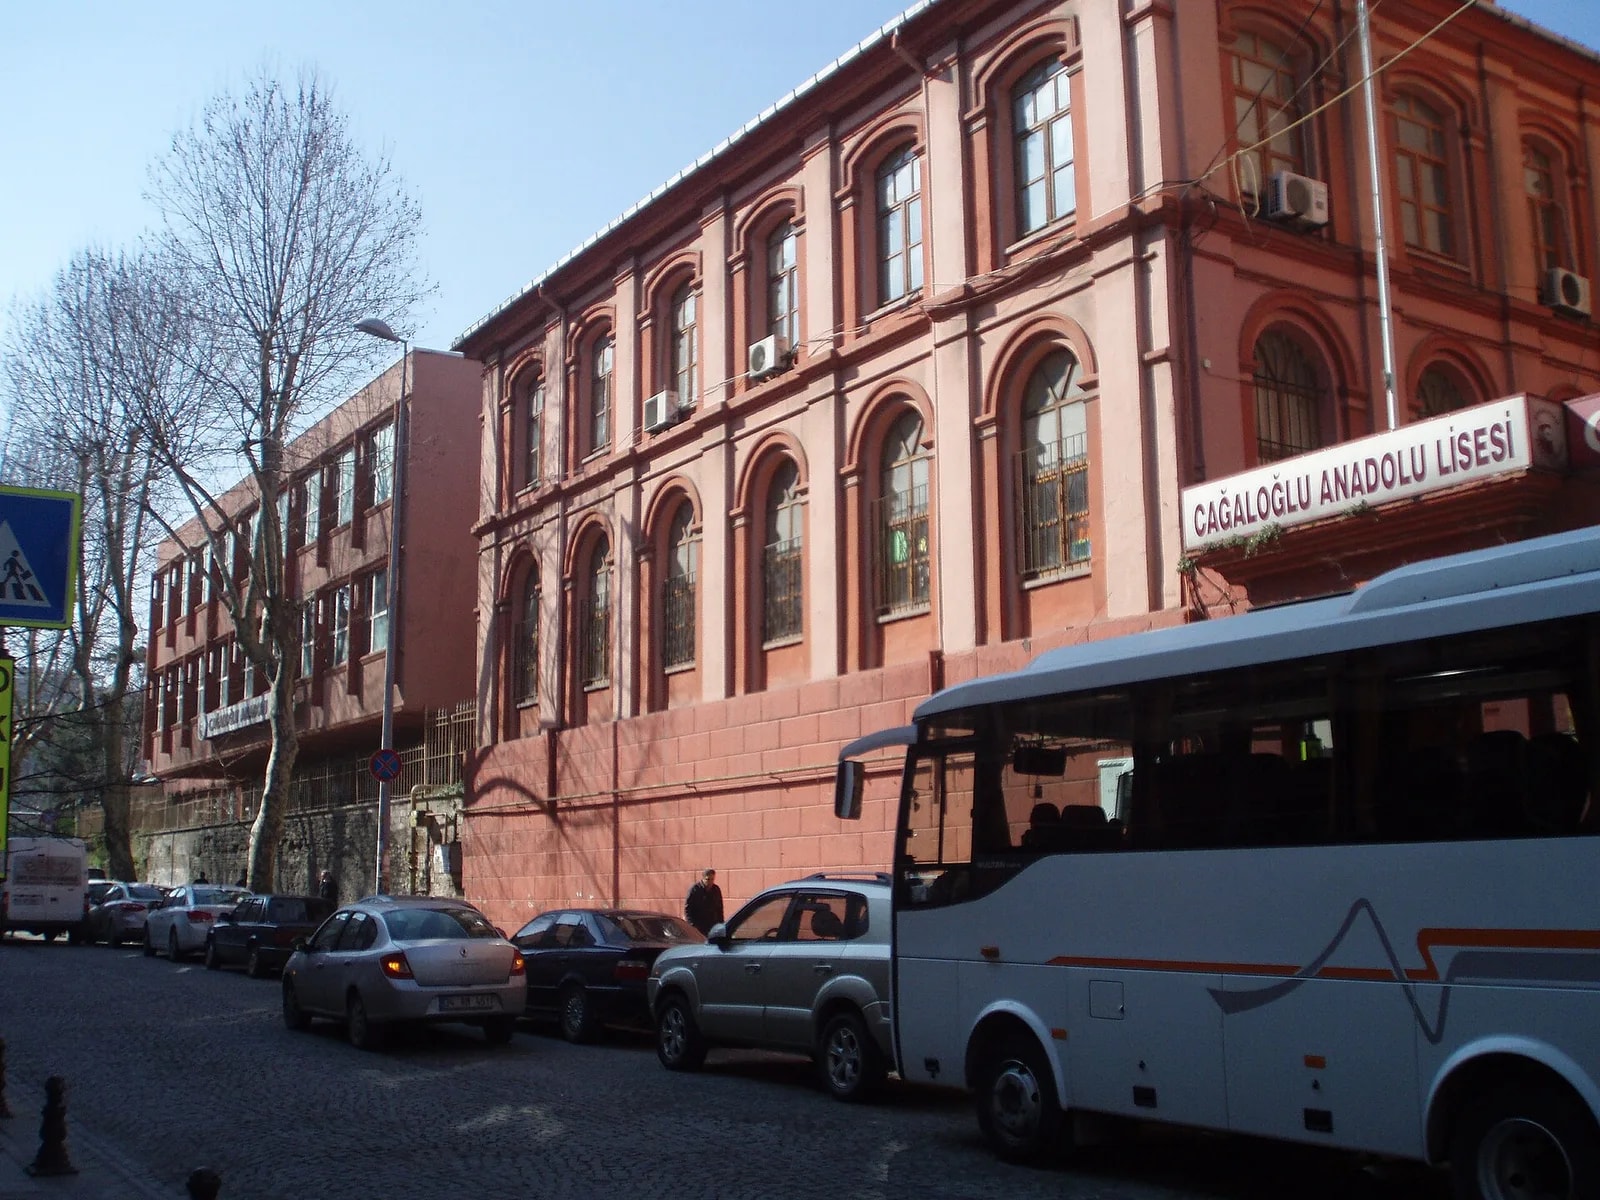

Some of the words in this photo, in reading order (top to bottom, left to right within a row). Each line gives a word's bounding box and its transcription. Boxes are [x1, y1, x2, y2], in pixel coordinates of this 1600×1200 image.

[1193, 472, 1312, 538] CAĞALOĞLU
[1319, 444, 1428, 504] ANADOLU
[1436, 411, 1516, 475] LİSESİ
